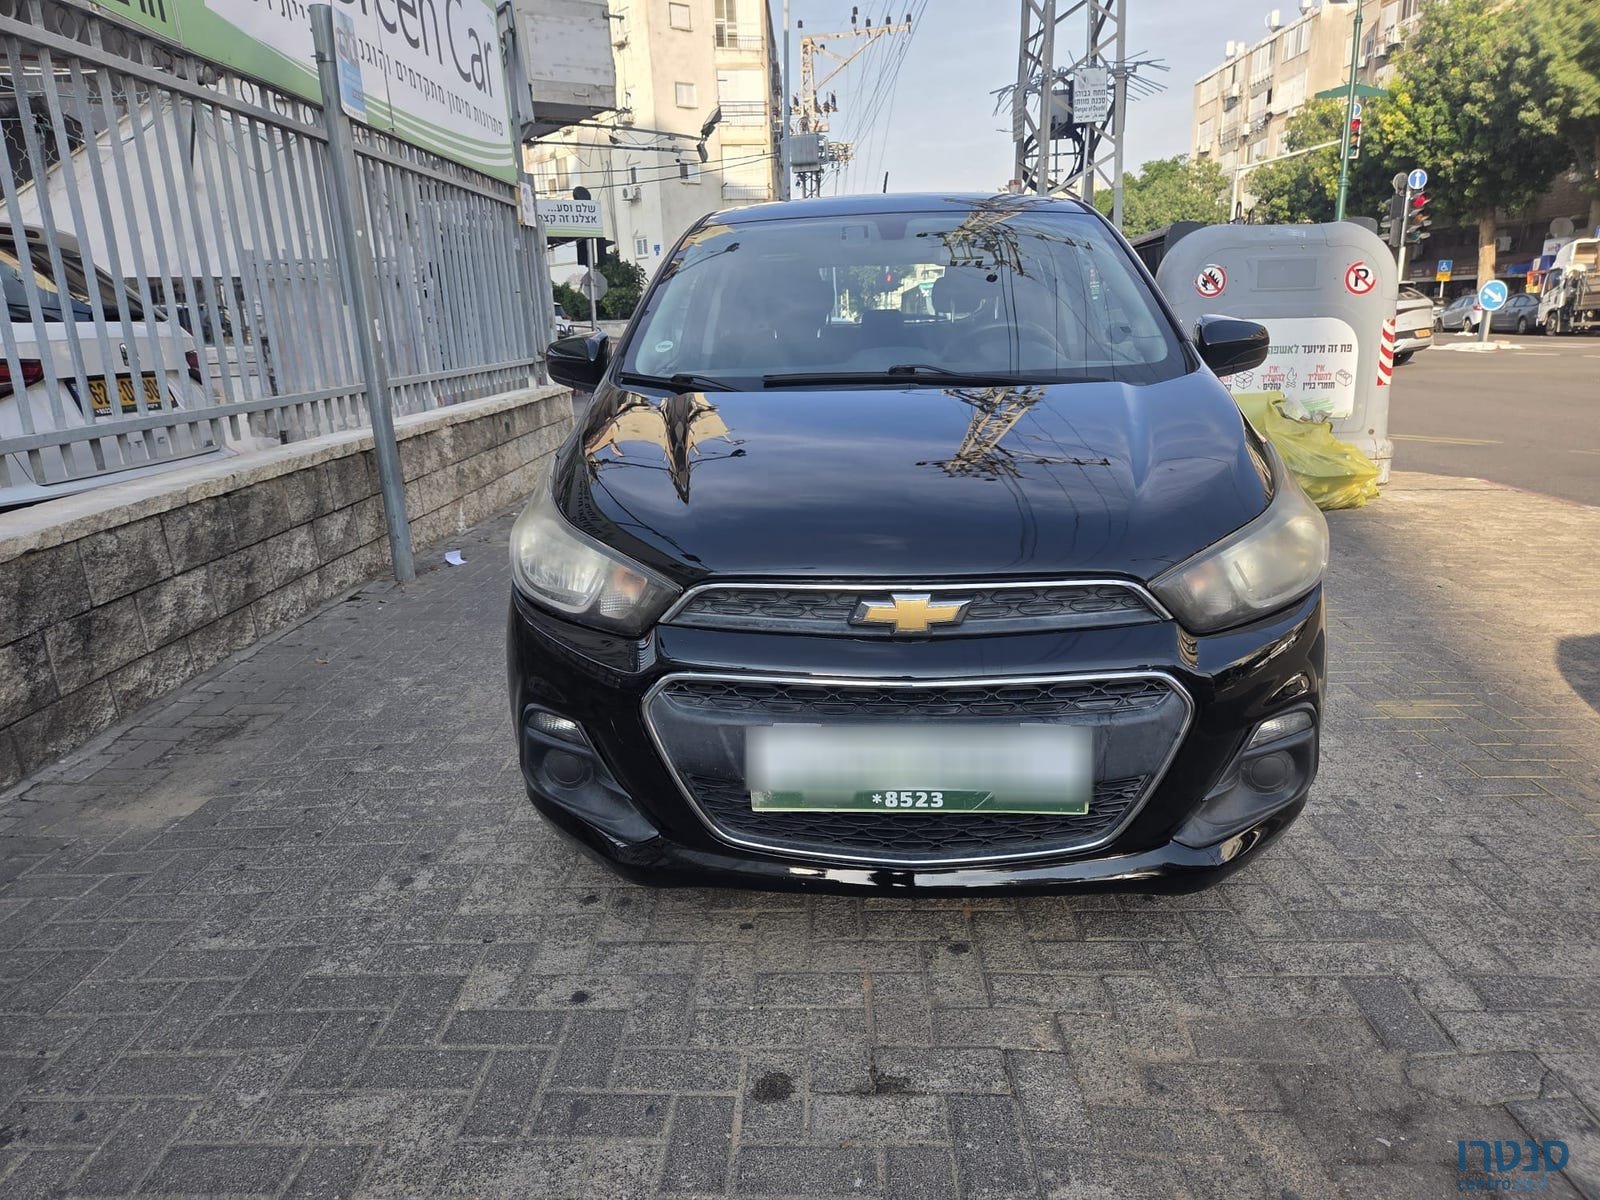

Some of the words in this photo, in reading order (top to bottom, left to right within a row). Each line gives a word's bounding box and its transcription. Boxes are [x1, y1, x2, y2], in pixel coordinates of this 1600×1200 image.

[446, 0, 493, 97] Car
[358, 38, 392, 75] והוגנ
[395, 60, 446, 104] מתקדמים
[447, 91, 472, 119] מימון
[576, 202, 596, 213] שלם
[559, 214, 569, 223] זה
[572, 214, 597, 223] אצלנו
[1354, 269, 1369, 287] P
[1301, 344, 1326, 354] מיועד
[1327, 344, 1338, 353] זה
[1340, 343, 1353, 353] פח
[1269, 365, 1279, 374] אין
[1315, 364, 1326, 373] אין
[1308, 372, 1332, 382] להשליך
[1302, 381, 1316, 391] בניין
[1317, 381, 1336, 390] חומרי
